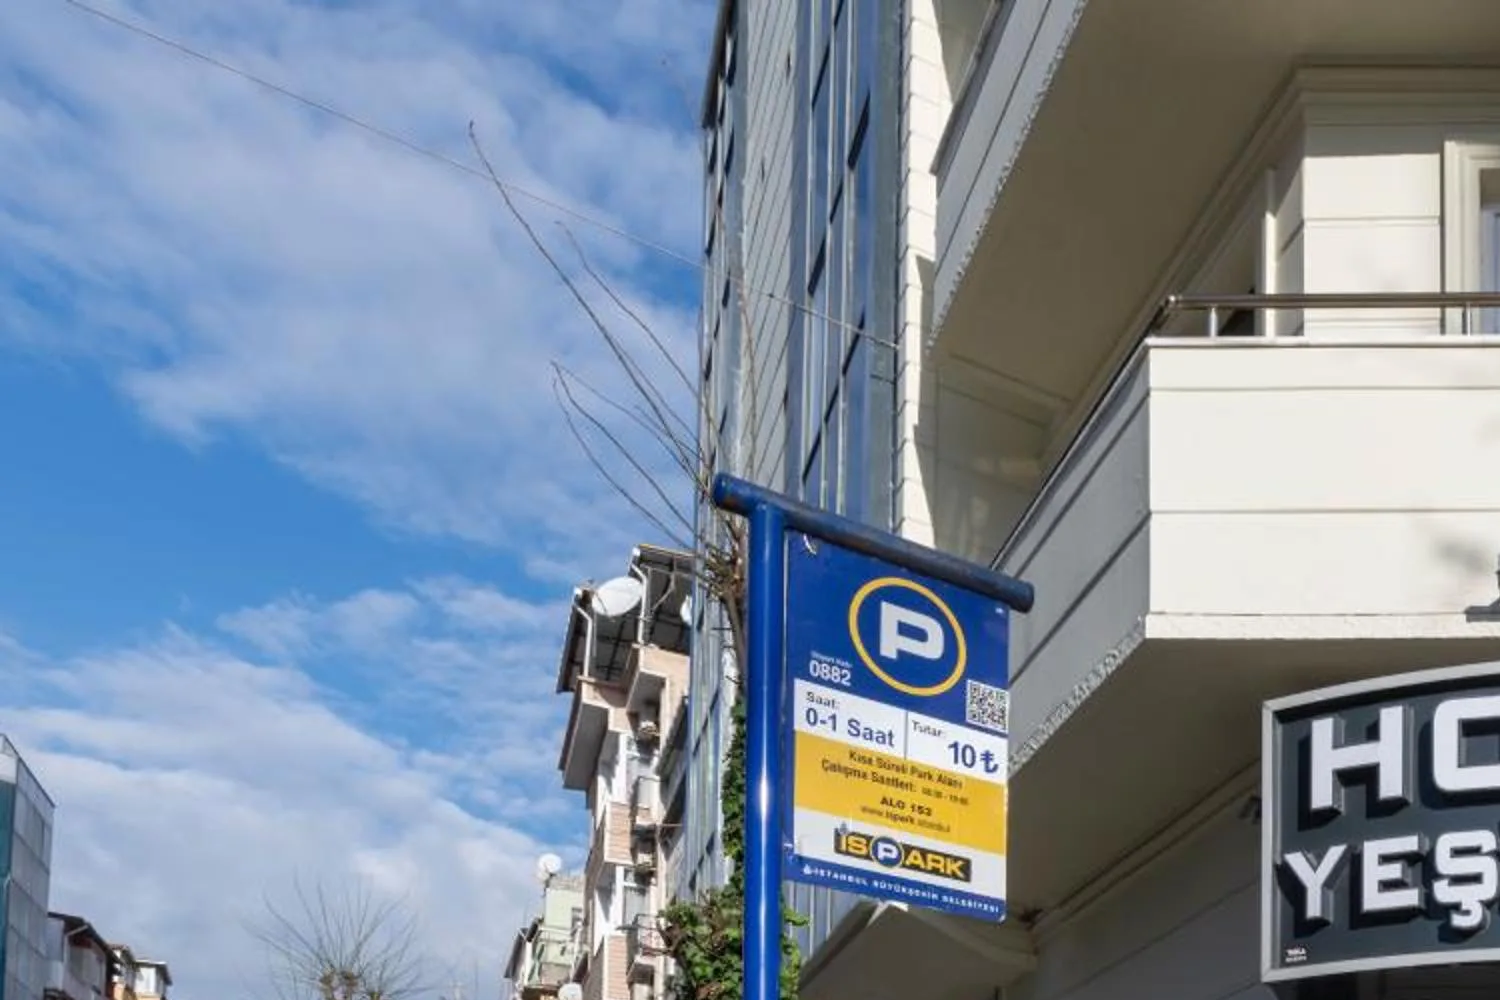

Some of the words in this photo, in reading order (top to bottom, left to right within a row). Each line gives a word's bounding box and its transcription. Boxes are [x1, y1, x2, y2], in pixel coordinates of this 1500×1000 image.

[880, 600, 945, 660] P
[809, 659, 851, 686] 0882
[805, 707, 838, 732] 0-1
[847, 718, 895, 747] Saat
[910, 766, 934, 781] Park
